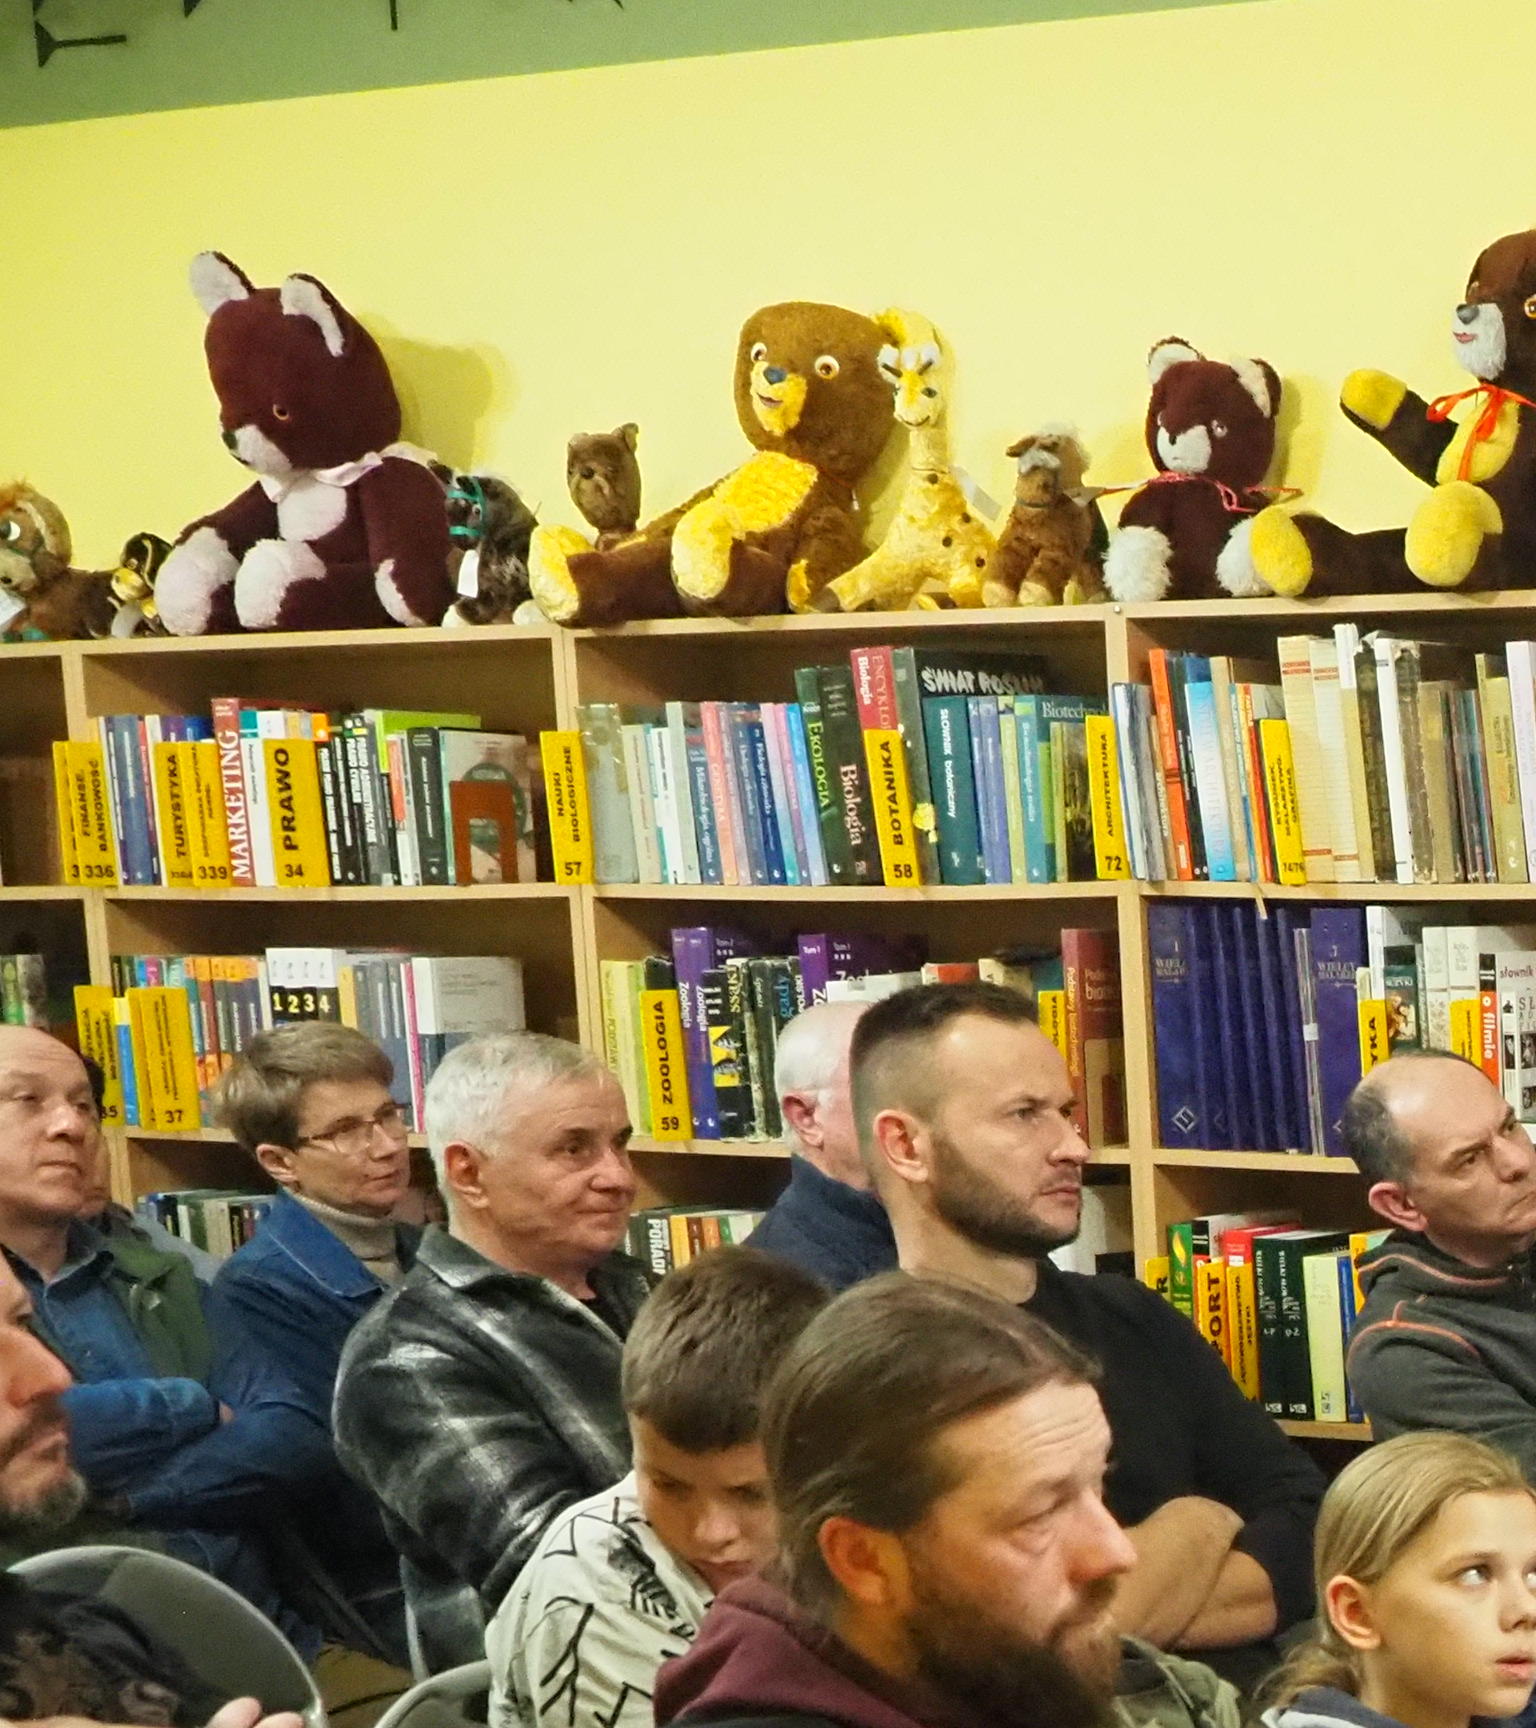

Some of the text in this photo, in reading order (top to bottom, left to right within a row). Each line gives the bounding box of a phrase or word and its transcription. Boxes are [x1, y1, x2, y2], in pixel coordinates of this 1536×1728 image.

[857, 656, 873, 705] Biologia
[941, 709, 952, 756] SŁOWNIK
[807, 720, 831, 808] EKOLOGIA
[1099, 733, 1115, 837] ARCHITEKTURA
[166, 754, 187, 858] TURYSTYKA
[219, 729, 251, 880] MARKETING
[274, 748, 299, 852] PRAWO
[549, 771, 564, 818] NAUKI
[562, 745, 581, 843] BIOLOGICZNE
[838, 763, 866, 847] Biologia
[880, 740, 904, 848] BOTANIKA
[85, 864, 114, 879] 336
[199, 865, 228, 880] 339
[285, 863, 304, 878] 34
[565, 862, 582, 877] 57
[895, 863, 913, 880] 58
[1104, 855, 1123, 873] 72
[1066, 967, 1076, 1011] Podstawy
[1500, 966, 1534, 979] słownik
[273, 992, 283, 1011] 1
[287, 994, 300, 1014] 2
[303, 992, 316, 1013] 3
[319, 994, 330, 1013] 4
[679, 981, 692, 1029] Zoologia
[695, 985, 707, 1032] Zoologia
[655, 1001, 674, 1105] ZOOLOGIA
[1483, 1012, 1496, 1060] filmie
[165, 1109, 183, 1124] 37
[661, 1116, 679, 1131] 59
